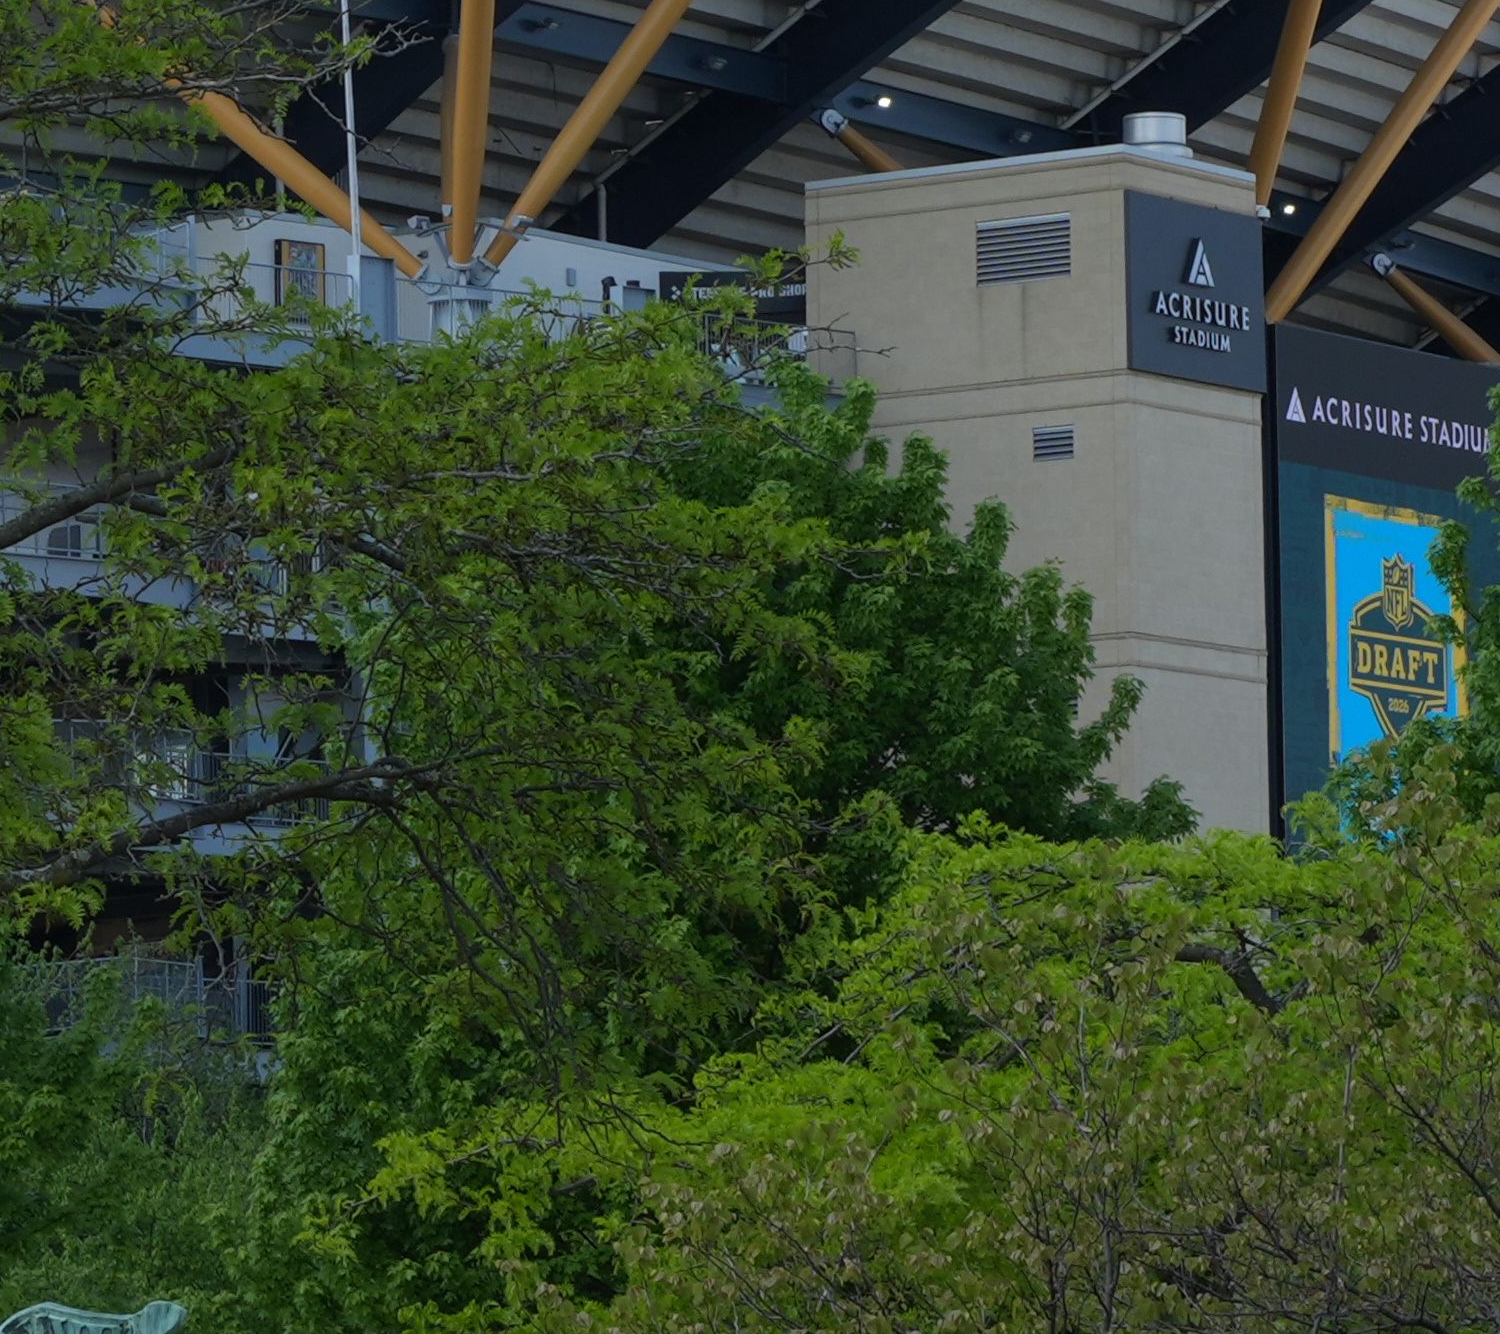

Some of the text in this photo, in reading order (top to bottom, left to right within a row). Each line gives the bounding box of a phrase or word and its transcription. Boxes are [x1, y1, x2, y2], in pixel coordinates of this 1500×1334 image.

[1155, 291, 1250, 331] ACRISURE
[1174, 326, 1231, 353] STADIUM
[1312, 395, 1413, 440] ACRISURE
[1385, 588, 1408, 617] NFL
[1356, 641, 1438, 685] DRAFT
[1387, 697, 1410, 713] 2026
